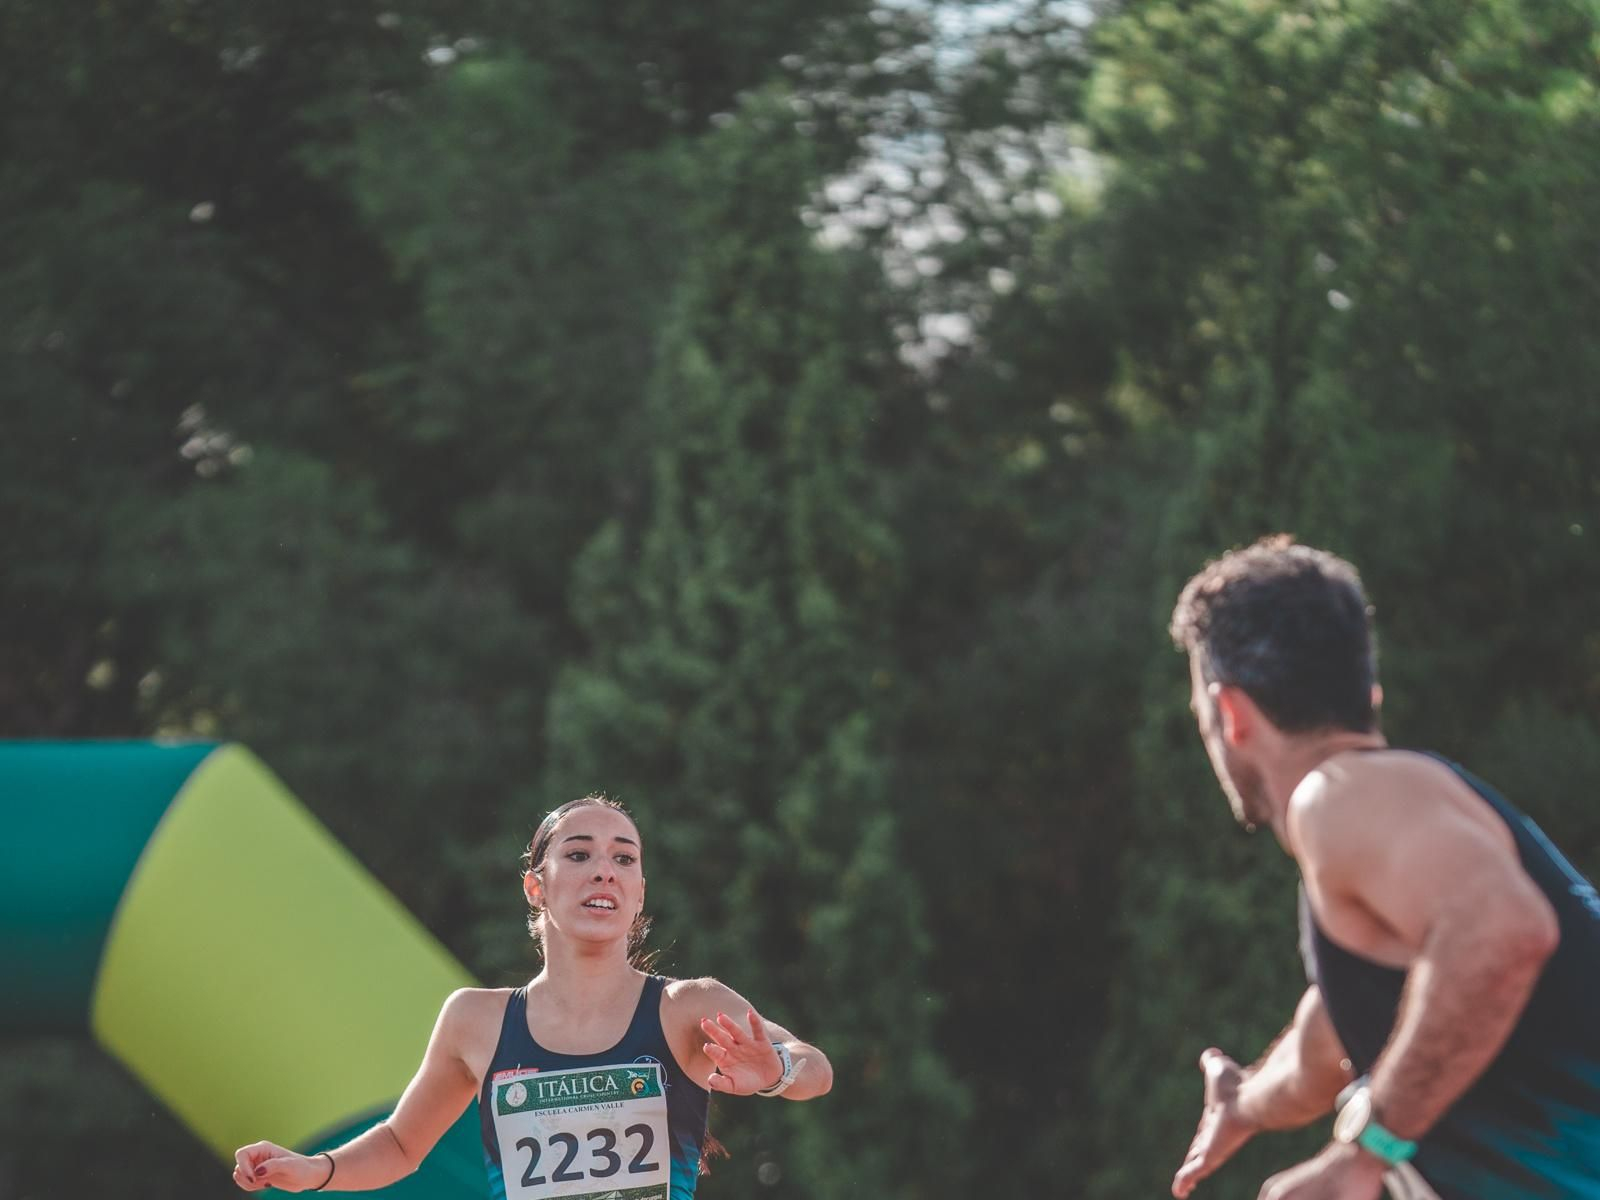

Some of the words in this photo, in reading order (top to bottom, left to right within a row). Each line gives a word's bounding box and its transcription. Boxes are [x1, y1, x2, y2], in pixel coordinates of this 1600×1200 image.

[537, 1075, 619, 1098] ITÁLICA
[535, 1109, 567, 1117] ESCUELA
[568, 1104, 600, 1113] CARMEN
[601, 1102, 625, 1110] VALLE
[516, 1123, 659, 1187] 2232
